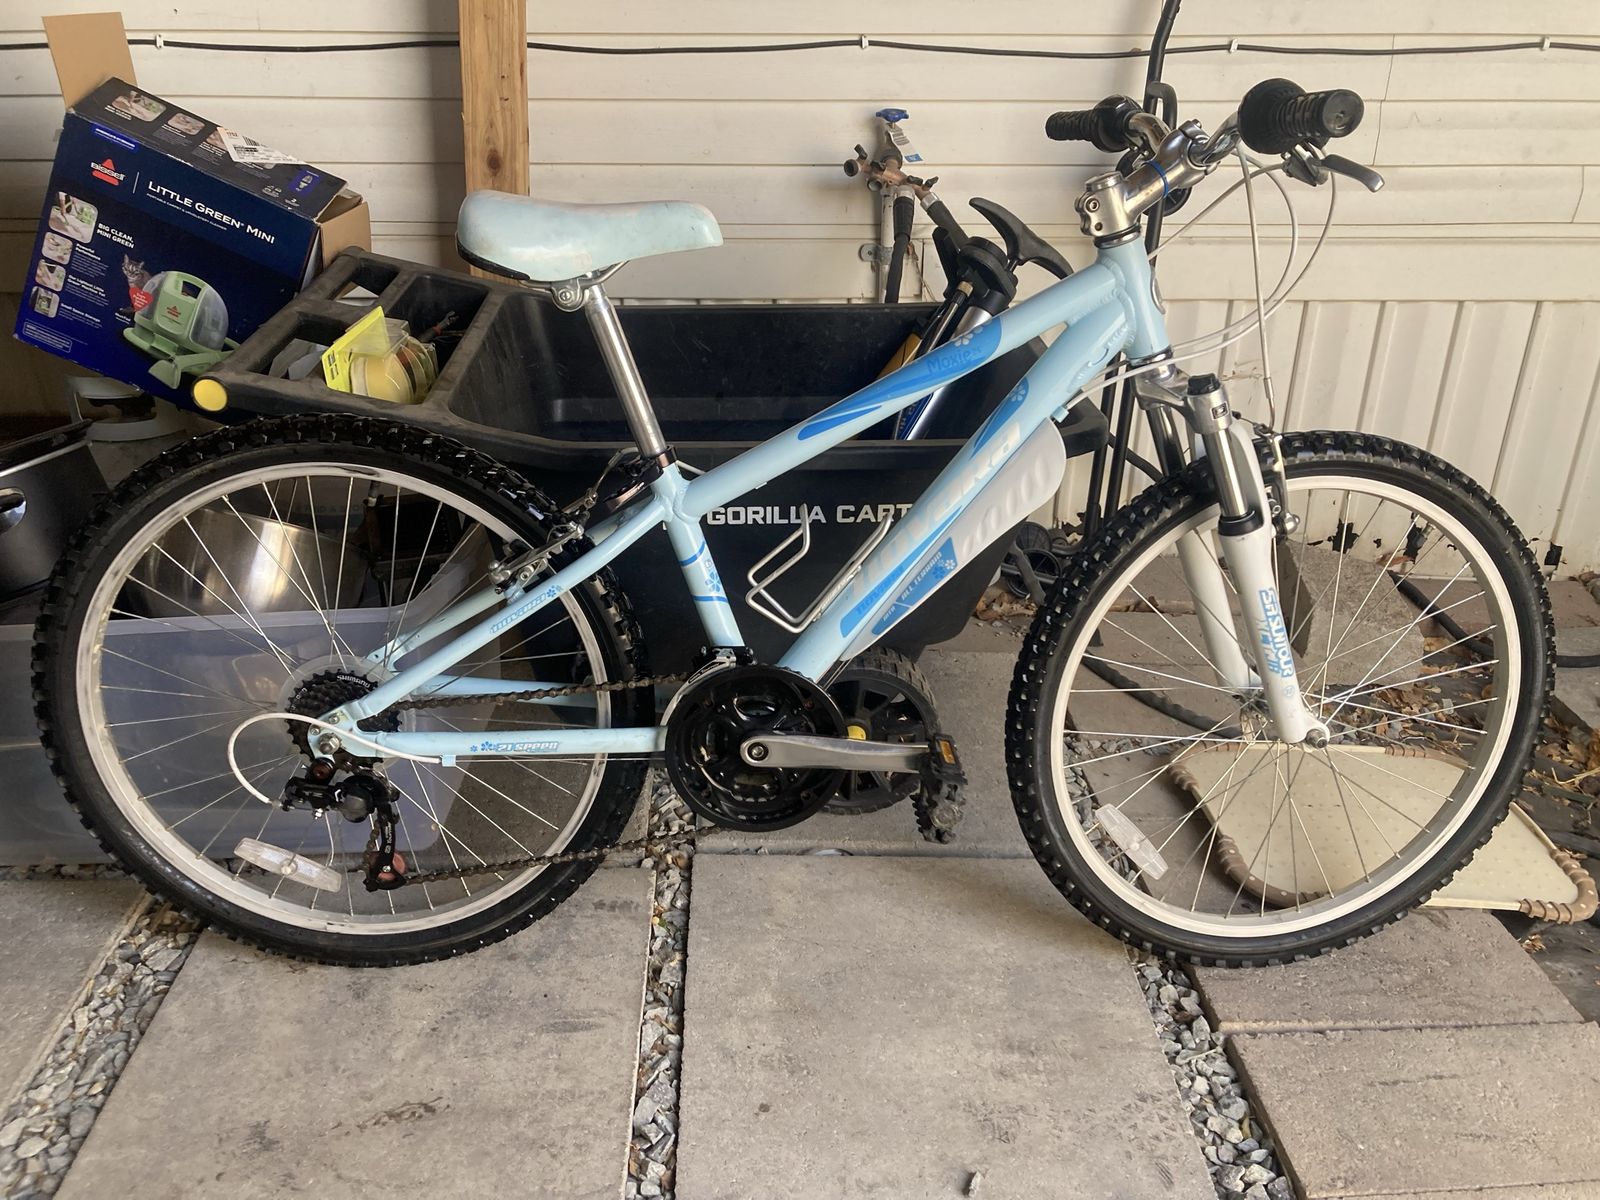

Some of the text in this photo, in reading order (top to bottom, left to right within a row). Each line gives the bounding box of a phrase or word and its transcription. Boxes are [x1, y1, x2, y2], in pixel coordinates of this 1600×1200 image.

[148, 181, 193, 208] LITTLE
[246, 225, 275, 244] MINI
[98, 223, 110, 233] BIG
[96, 229, 135, 249] MINI GREEN
[706, 506, 826, 525] GORILLA
[1266, 614, 1295, 678] SUNTOUR
